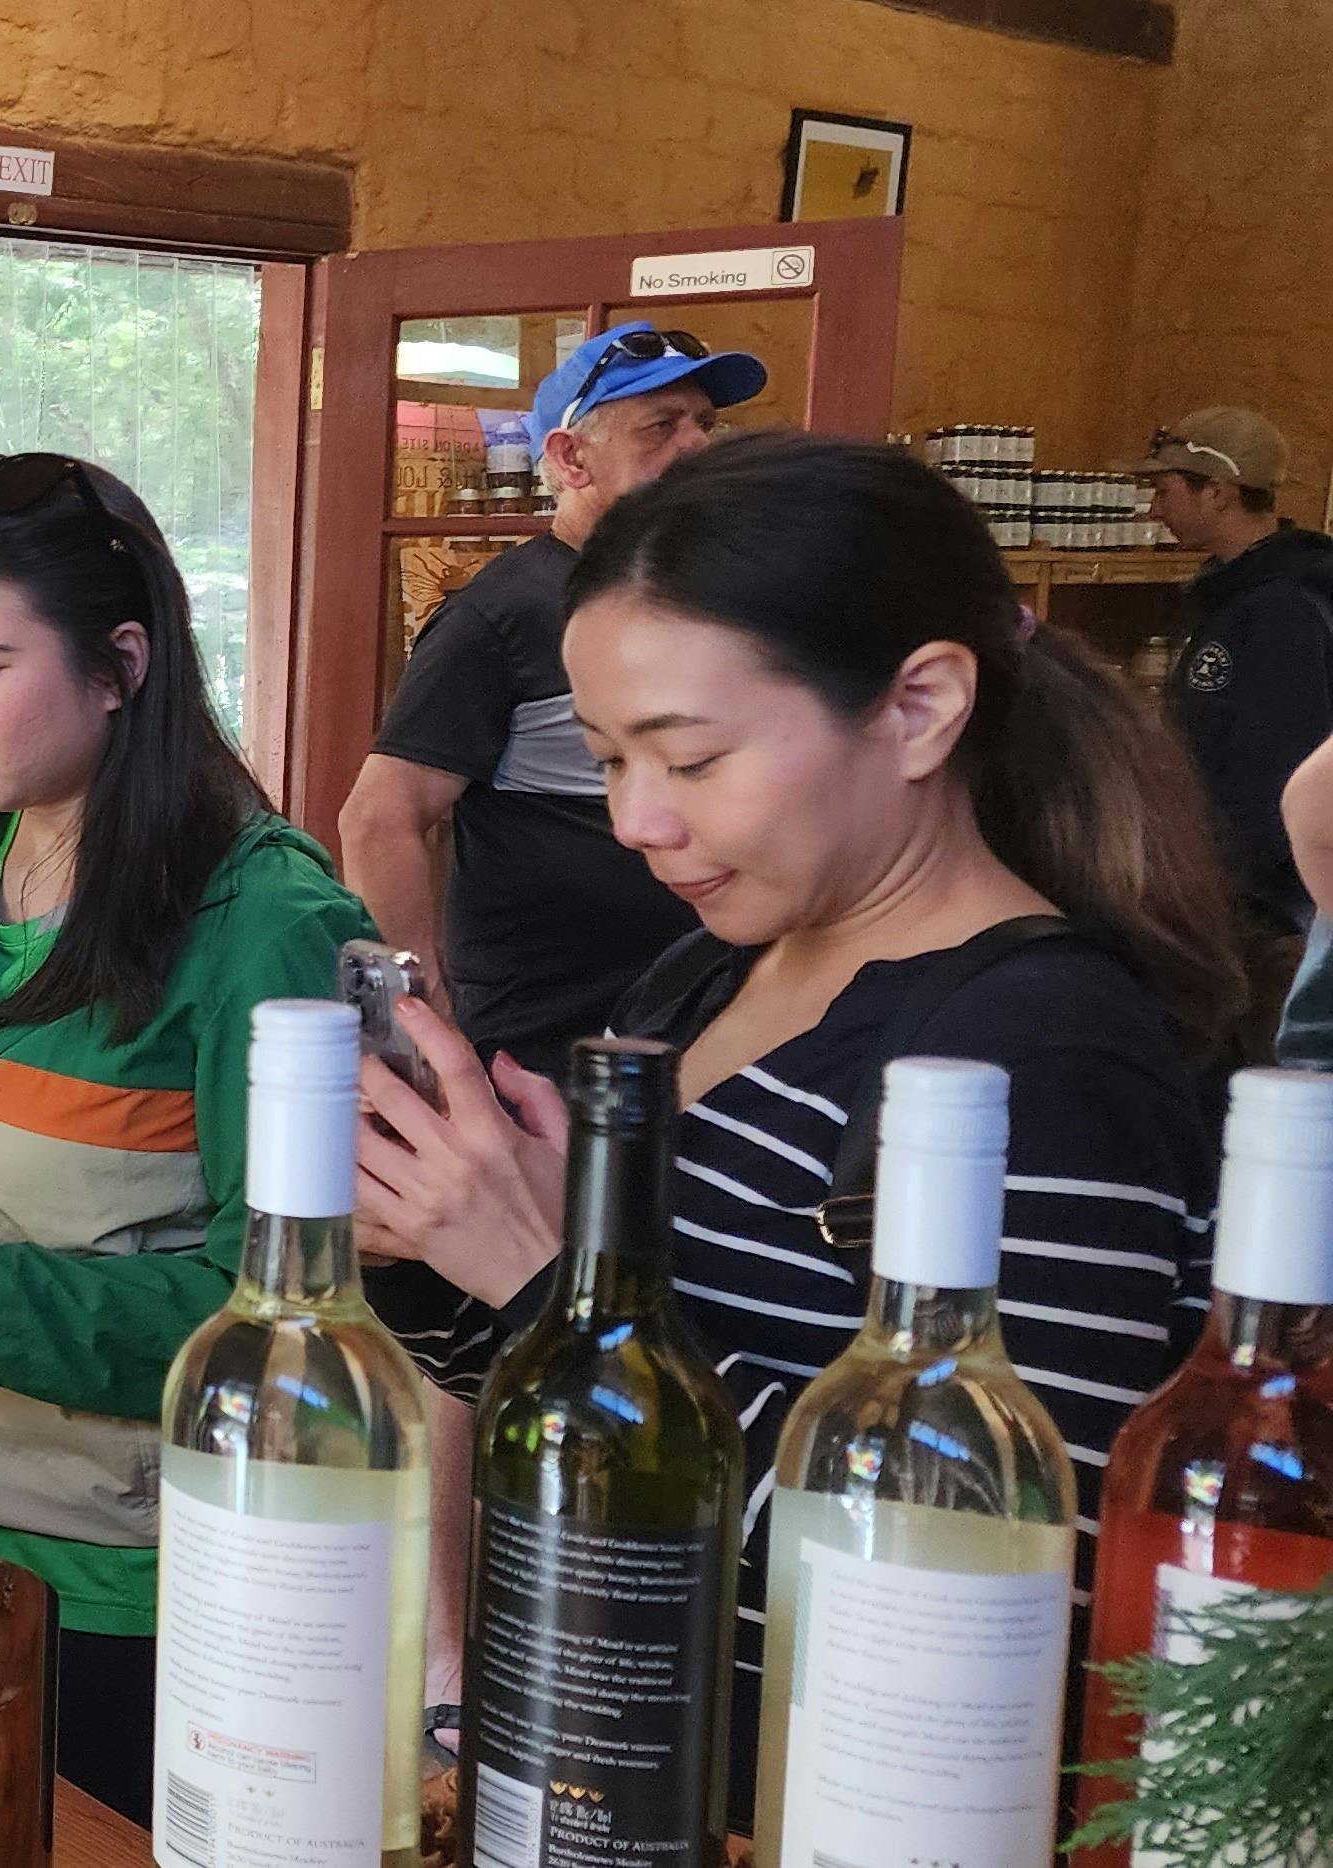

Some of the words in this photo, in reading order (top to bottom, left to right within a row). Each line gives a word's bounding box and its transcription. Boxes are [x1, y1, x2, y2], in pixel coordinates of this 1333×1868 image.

[639, 275, 664, 290] No
[668, 270, 747, 287] Smoking
[550, 1825, 611, 1849] PRODUCT
[613, 1840, 631, 1851] OF
